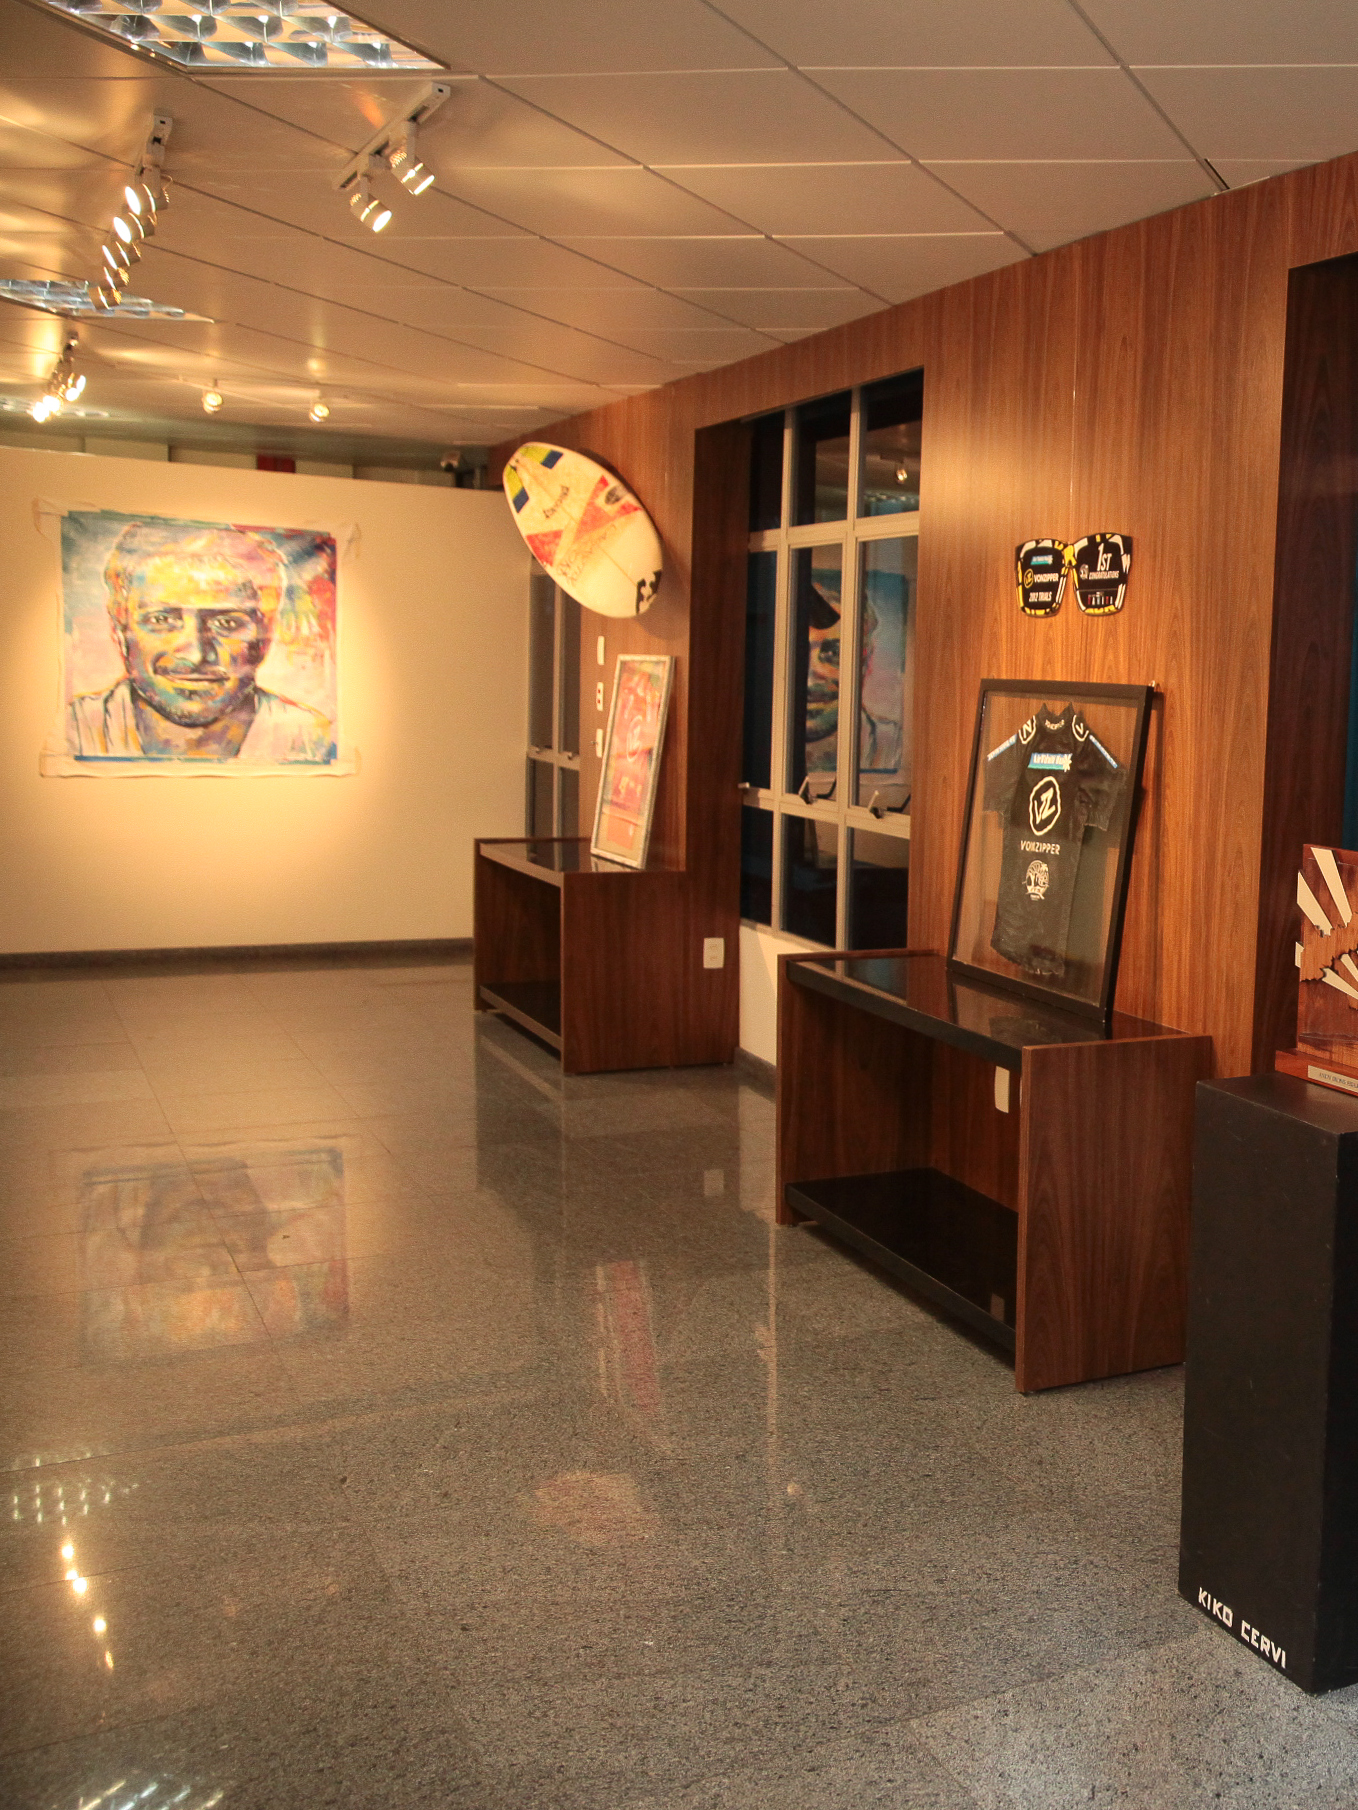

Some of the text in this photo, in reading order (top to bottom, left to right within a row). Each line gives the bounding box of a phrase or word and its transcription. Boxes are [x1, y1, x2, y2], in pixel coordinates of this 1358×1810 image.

[1097, 543, 1112, 571] 1ST
[1033, 572, 1059, 583] VONZIPPER
[1038, 591, 1052, 601] TRIALS
[1020, 840, 1060, 855] VONZIPPER
[1199, 1587, 1286, 1669] KIKO CERVI
